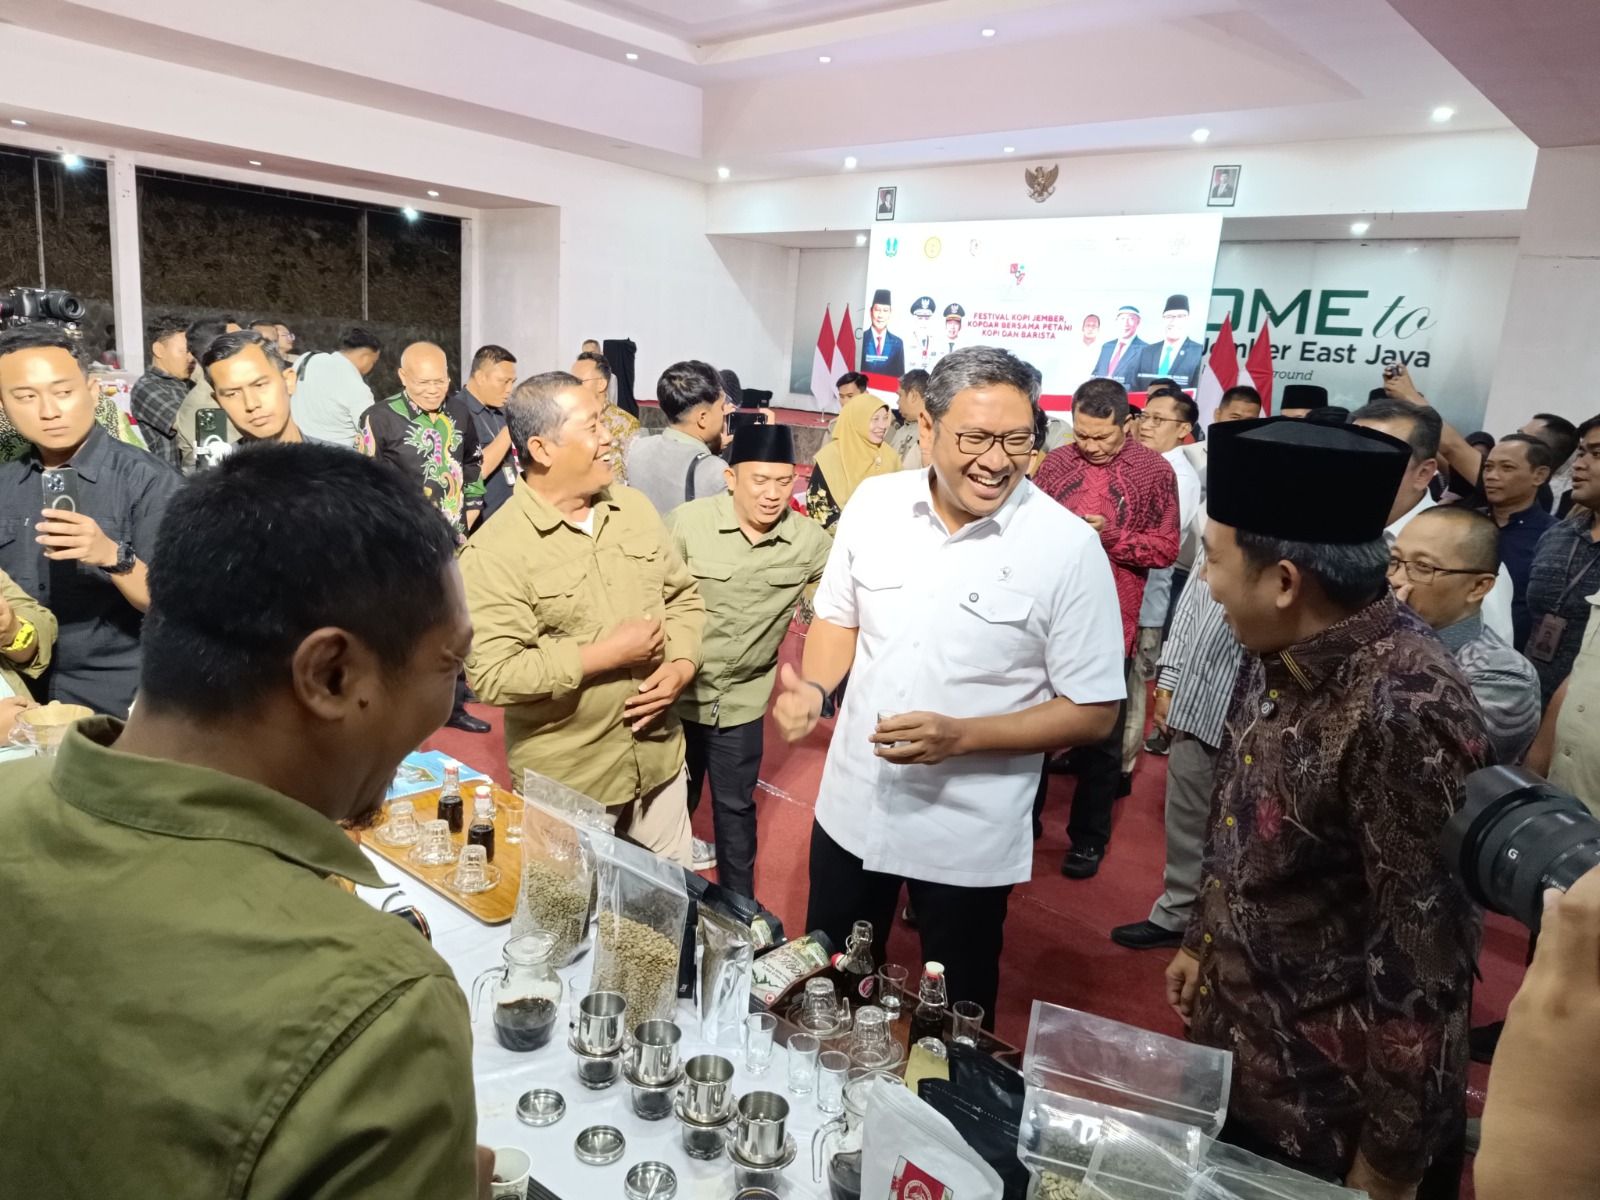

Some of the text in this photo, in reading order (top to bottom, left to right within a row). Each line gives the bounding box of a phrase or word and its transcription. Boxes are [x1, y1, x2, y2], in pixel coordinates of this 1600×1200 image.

[974, 313, 1009, 321] FESTIVAL
[1011, 314, 1030, 322] KOPI
[1372, 295, 1437, 339] to
[967, 320, 1073, 331] KOPDAR BERSAMA PETANI
[982, 329, 1056, 339] KOPI DAN BARISTA
[1300, 341, 1357, 365] East
[1365, 344, 1431, 368] Java
